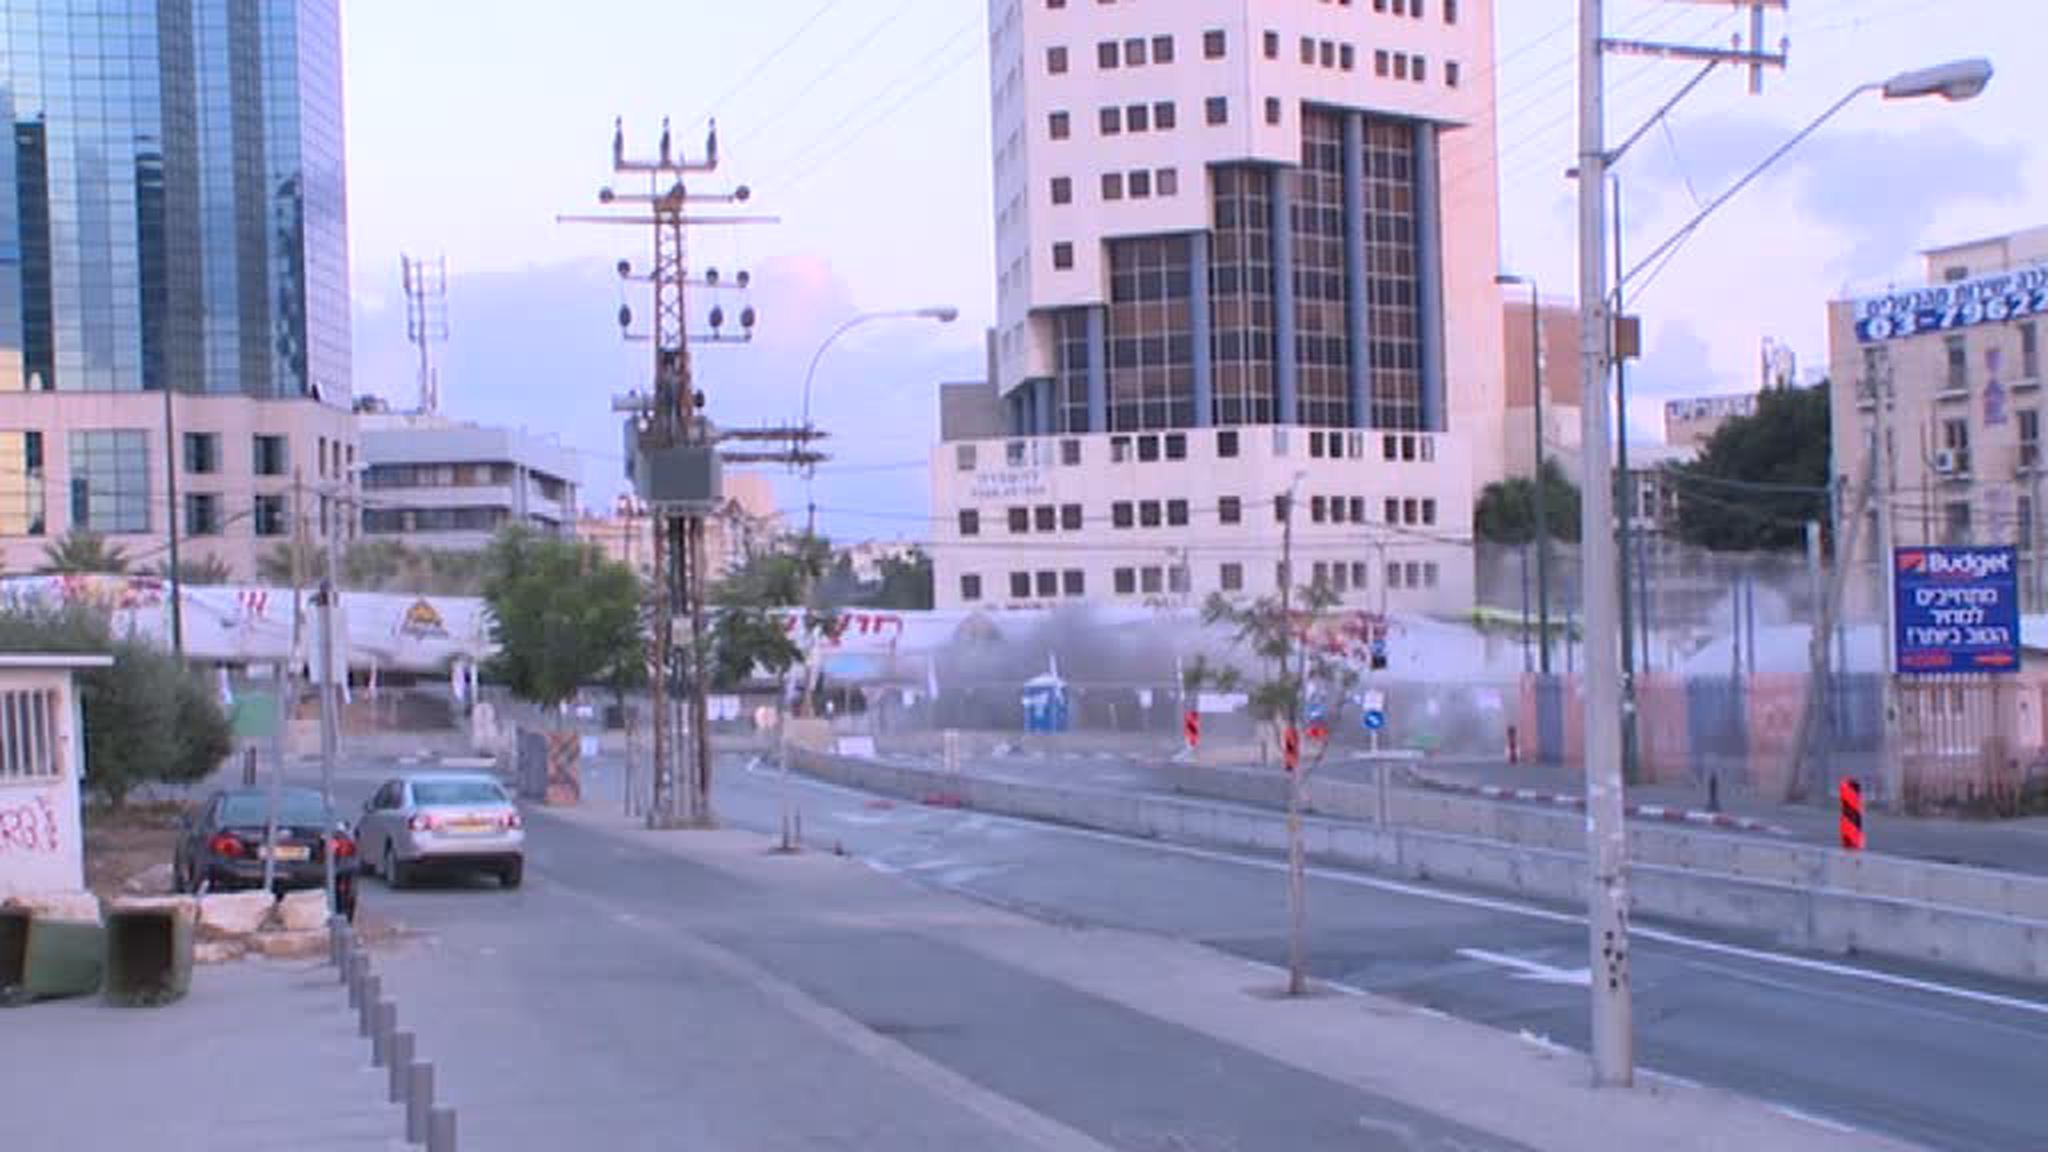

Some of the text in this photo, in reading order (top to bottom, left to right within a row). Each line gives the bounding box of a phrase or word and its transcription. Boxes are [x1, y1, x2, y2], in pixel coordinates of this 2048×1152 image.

[1928, 552, 2010, 577] Budget
[1930, 606, 1984, 625] למחיר
[1965, 627, 2009, 645] הטוב
